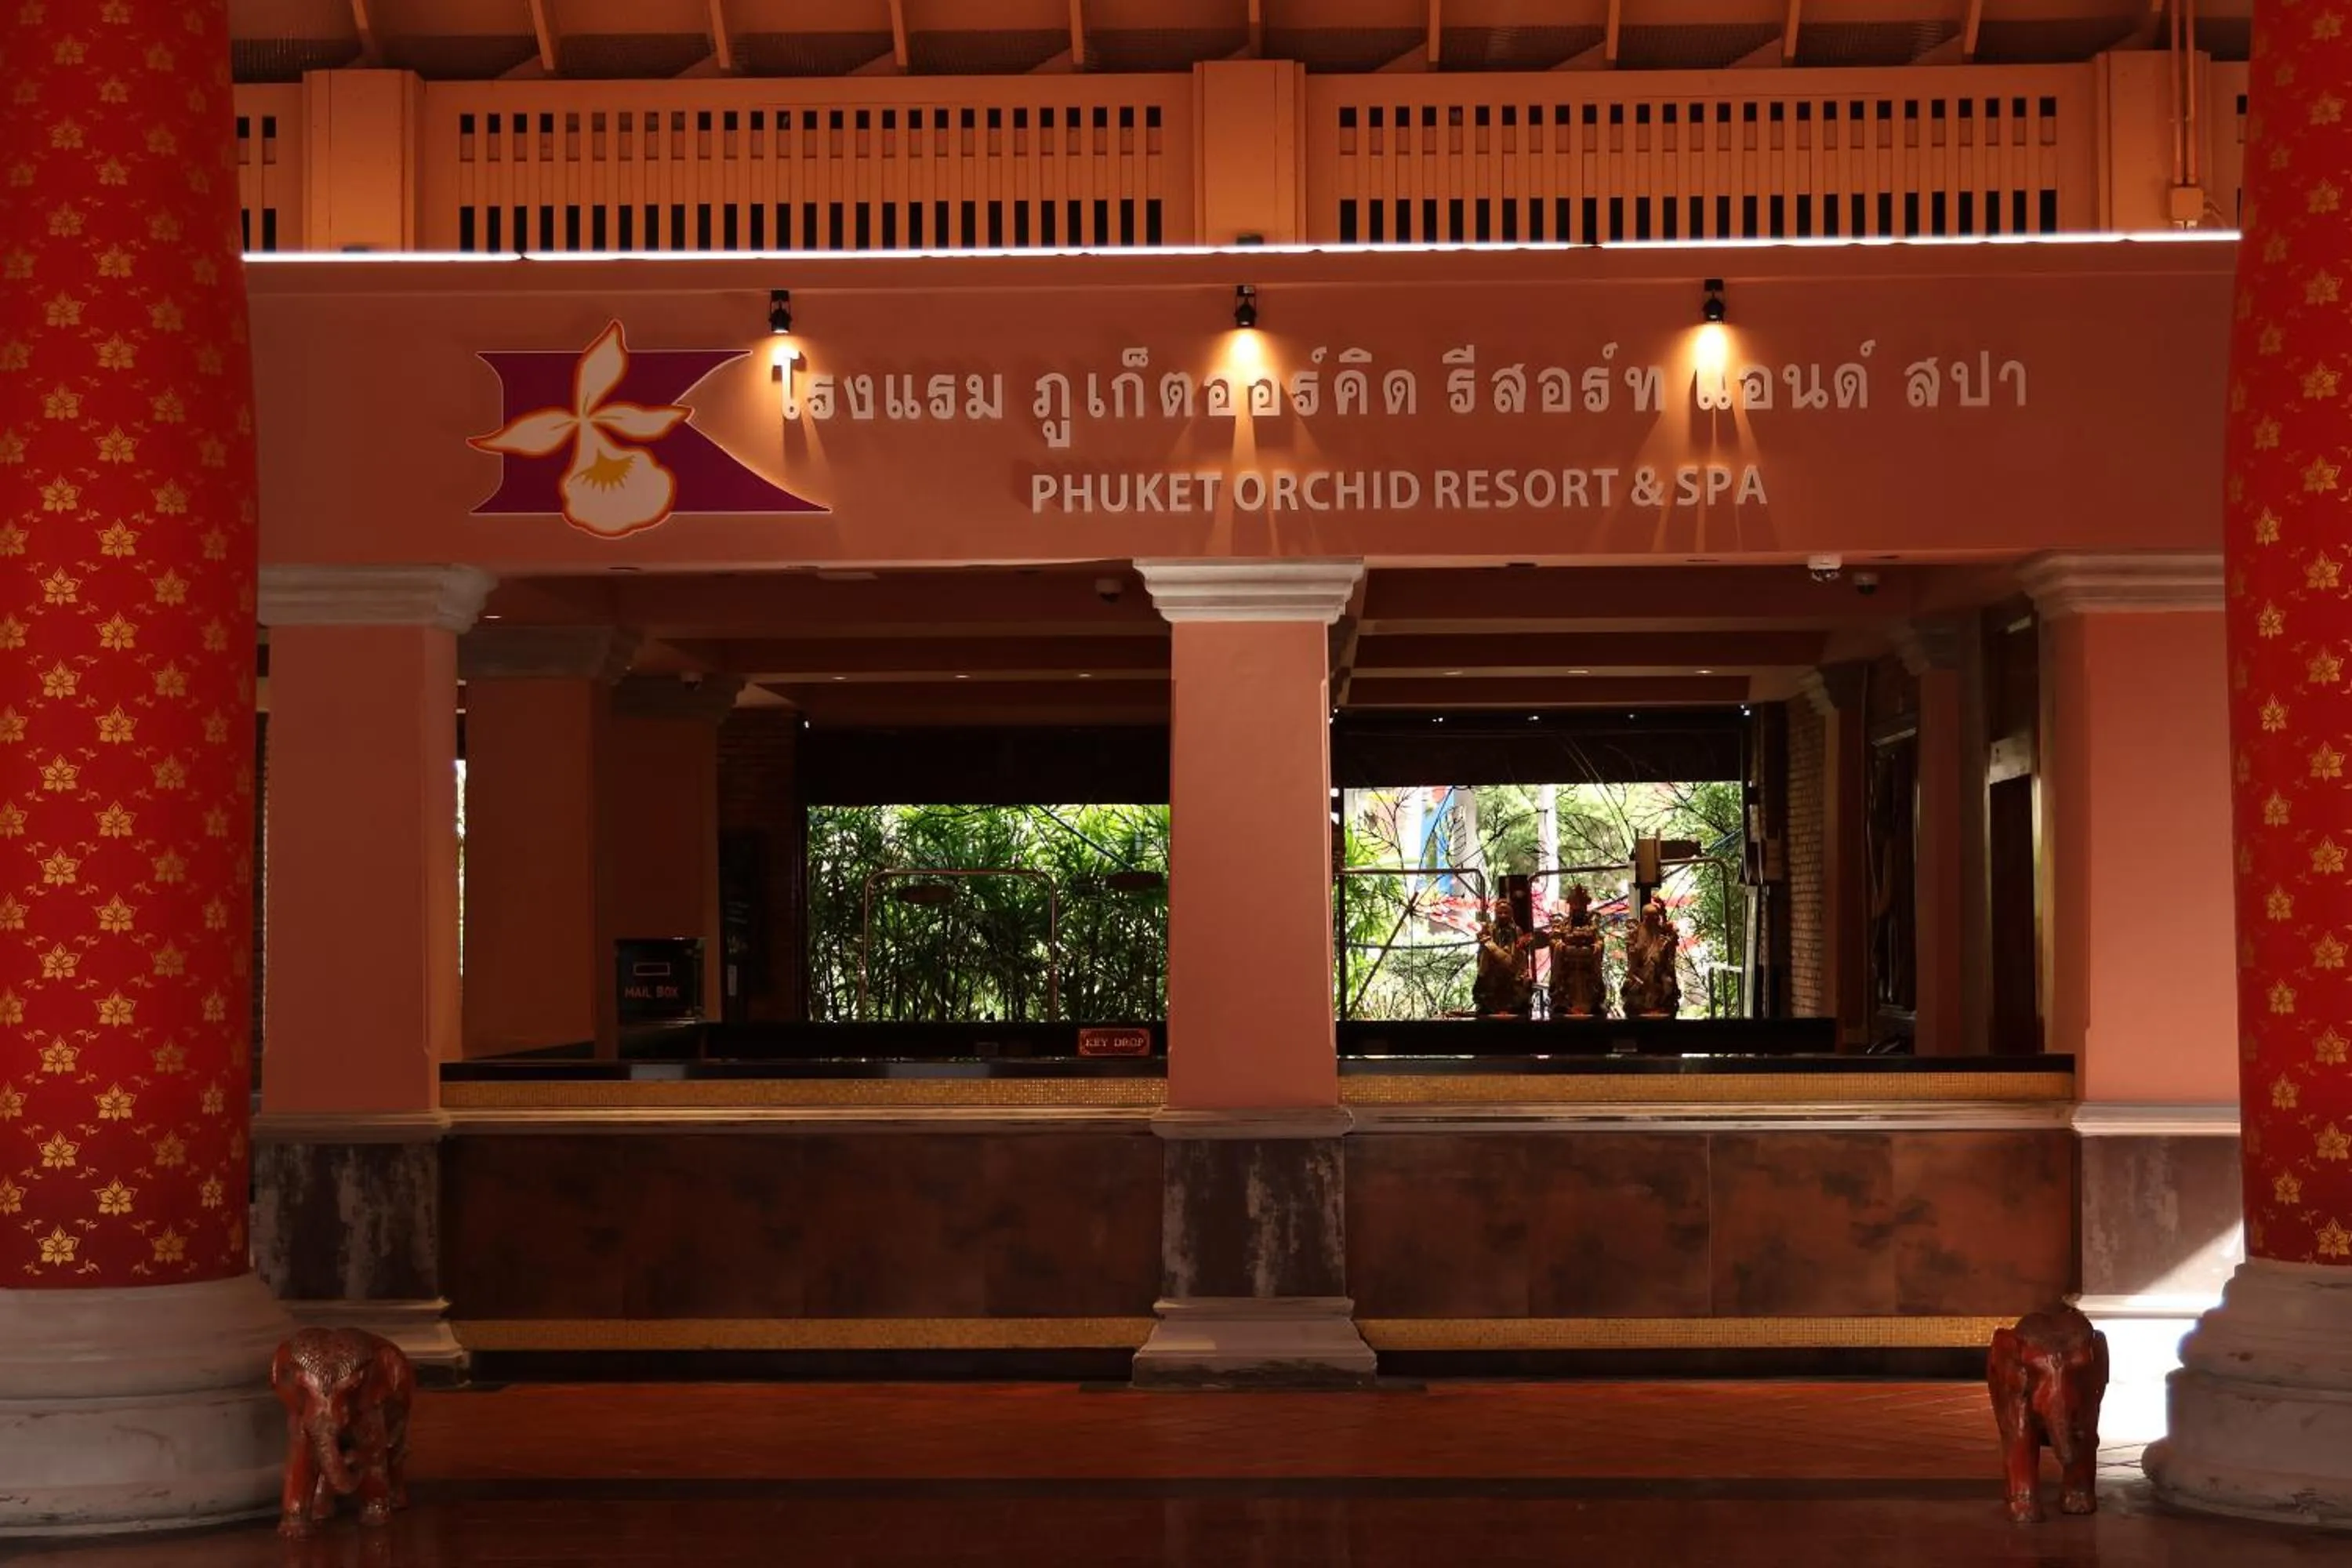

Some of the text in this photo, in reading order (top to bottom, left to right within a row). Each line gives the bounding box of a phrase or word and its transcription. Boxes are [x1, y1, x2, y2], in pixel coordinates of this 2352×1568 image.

[773, 350, 1004, 421] โรงแรม
[1442, 343, 1664, 413] รีสอร์ท
[1904, 350, 2028, 408] สปา
[1032, 464, 1769, 514] PHUKET ORCHID RESORT & SPA
[624, 985, 652, 999] MAIL
[1085, 1037, 1145, 1047] KEY DROP
